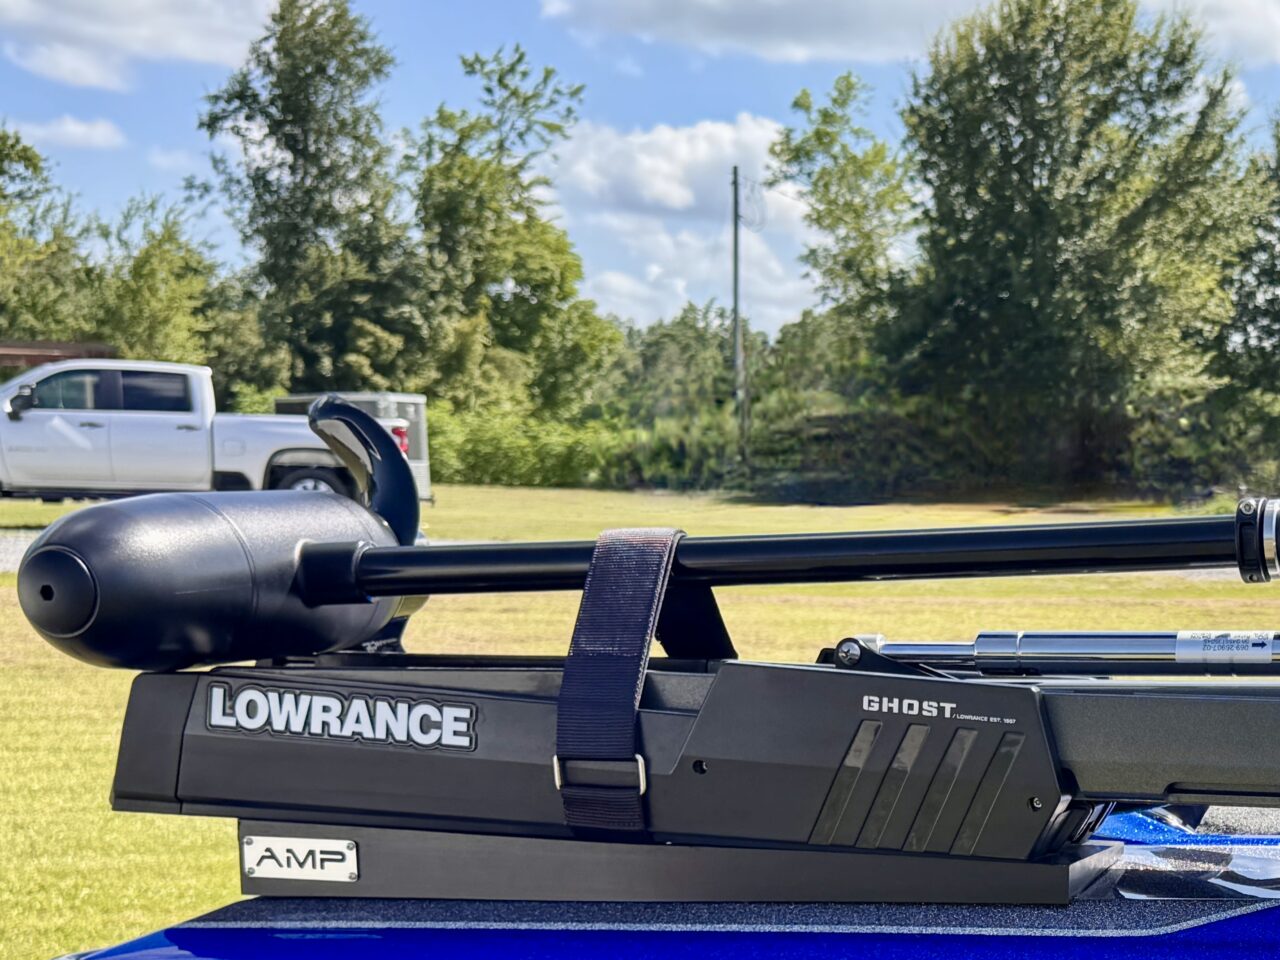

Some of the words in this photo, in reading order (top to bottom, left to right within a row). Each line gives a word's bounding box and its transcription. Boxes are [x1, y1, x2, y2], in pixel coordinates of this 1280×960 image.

[210, 686, 471, 746] LOWRANCE
[862, 695, 956, 718] GHOST
[256, 847, 347, 871] AMP
